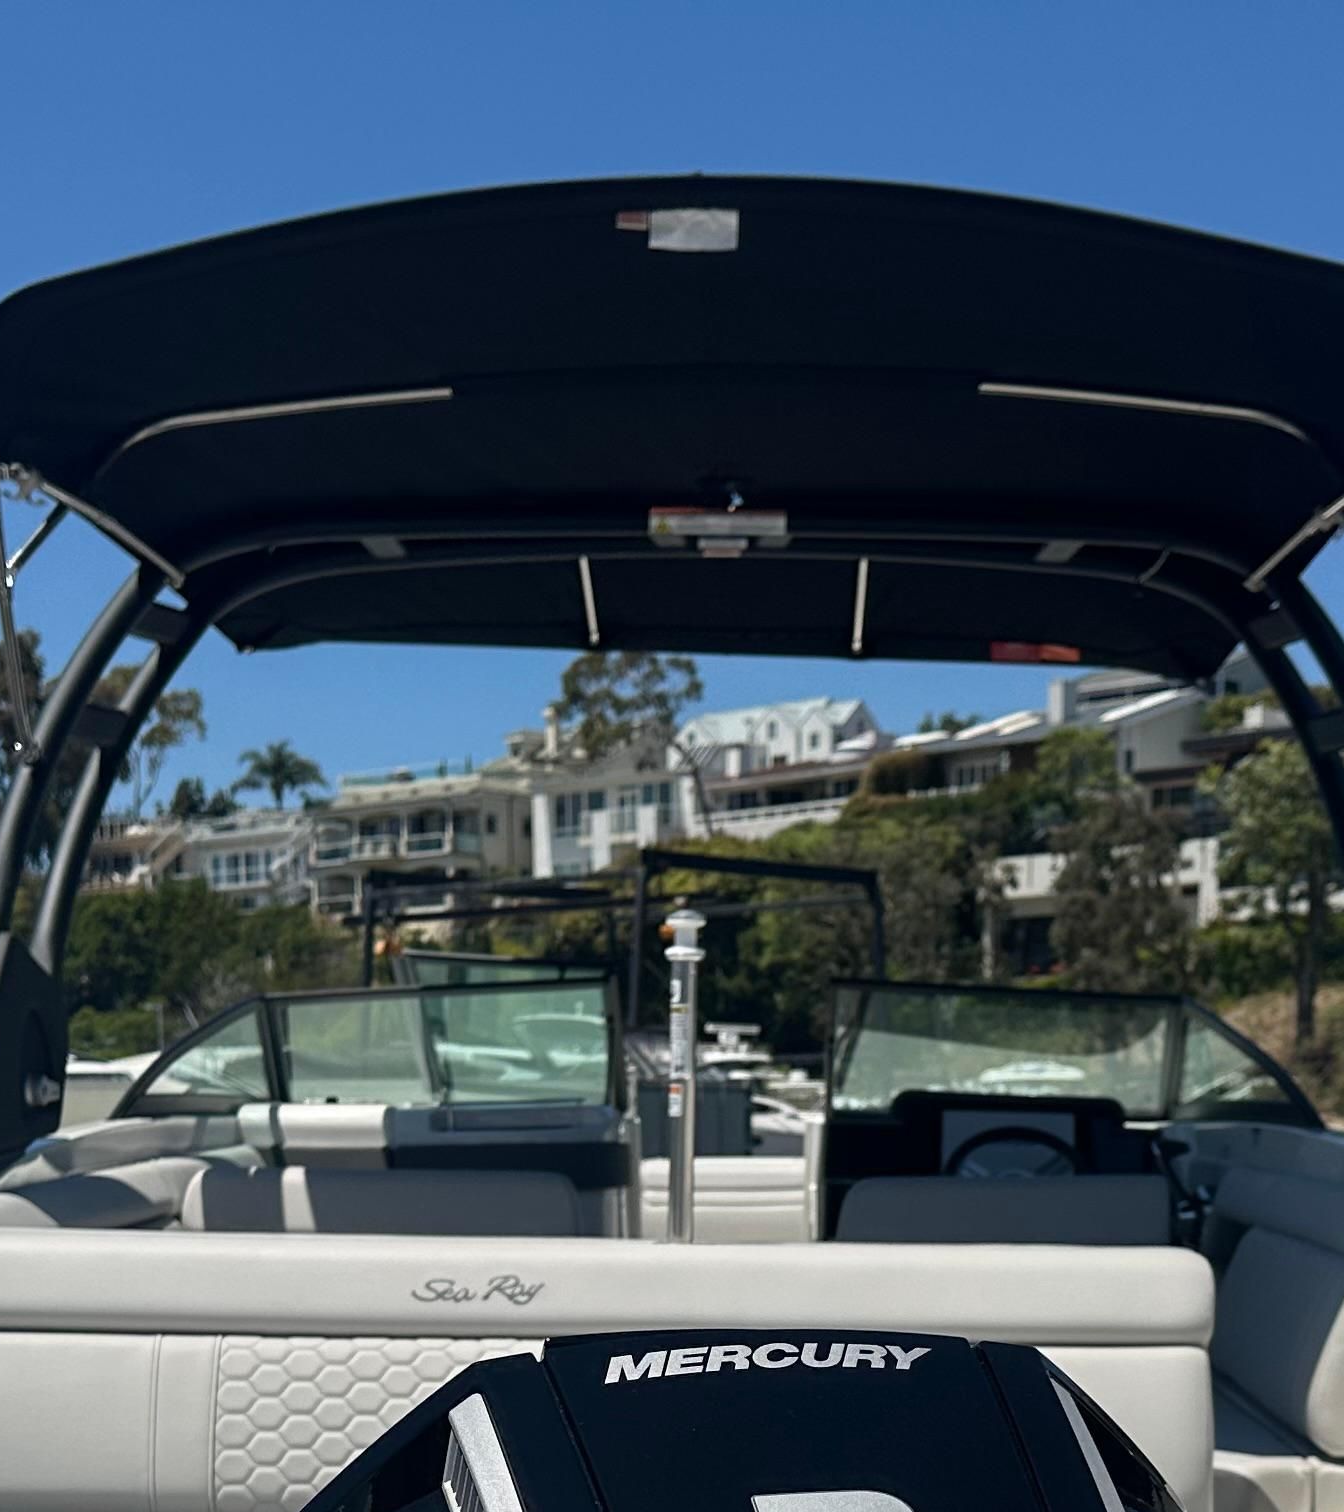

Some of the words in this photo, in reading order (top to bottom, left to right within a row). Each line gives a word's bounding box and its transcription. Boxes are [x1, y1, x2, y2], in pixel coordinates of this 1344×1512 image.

[411, 1278, 477, 1303] Sea
[482, 1274, 546, 1306] Ray
[604, 1342, 932, 1384] MERCURY
